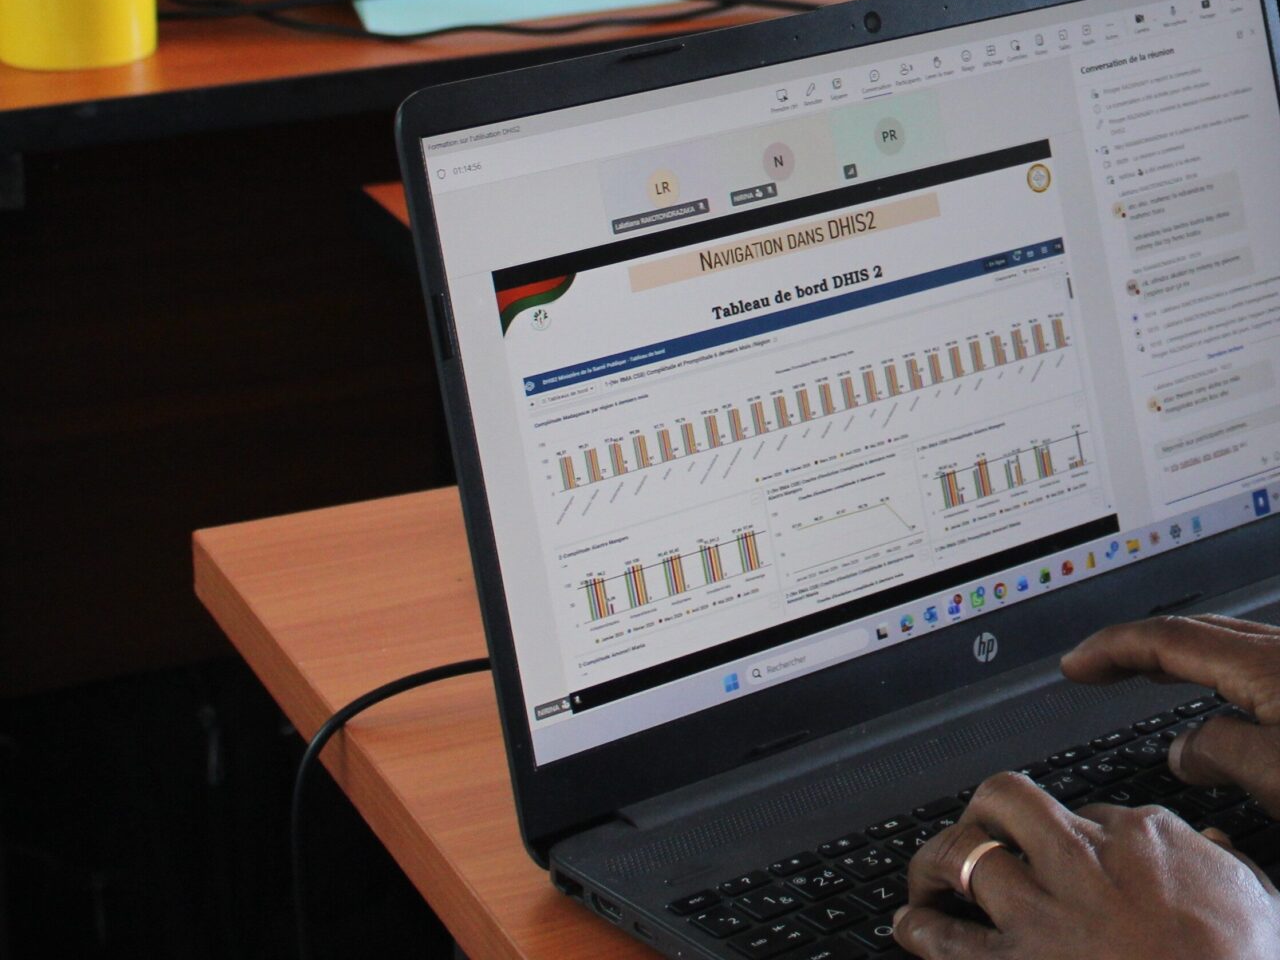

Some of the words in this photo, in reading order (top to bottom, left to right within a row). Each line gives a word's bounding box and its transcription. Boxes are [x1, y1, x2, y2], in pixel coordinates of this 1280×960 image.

[1079, 56, 1128, 75] Conversation
[1127, 53, 1139, 64] de
[1138, 51, 1147, 62] la
[1146, 45, 1175, 60] réunion
[880, 128, 898, 143] PR
[451, 161, 482, 175] 01:14:56
[772, 154, 784, 168] N
[653, 180, 671, 196] LR
[826, 209, 877, 241] DHIS2
[711, 292, 771, 321] Tableau
[772, 287, 792, 305] de
[794, 278, 829, 300] bord
[831, 267, 870, 290] DHIS
[871, 264, 884, 280] 2
[973, 632, 998, 663] hp
